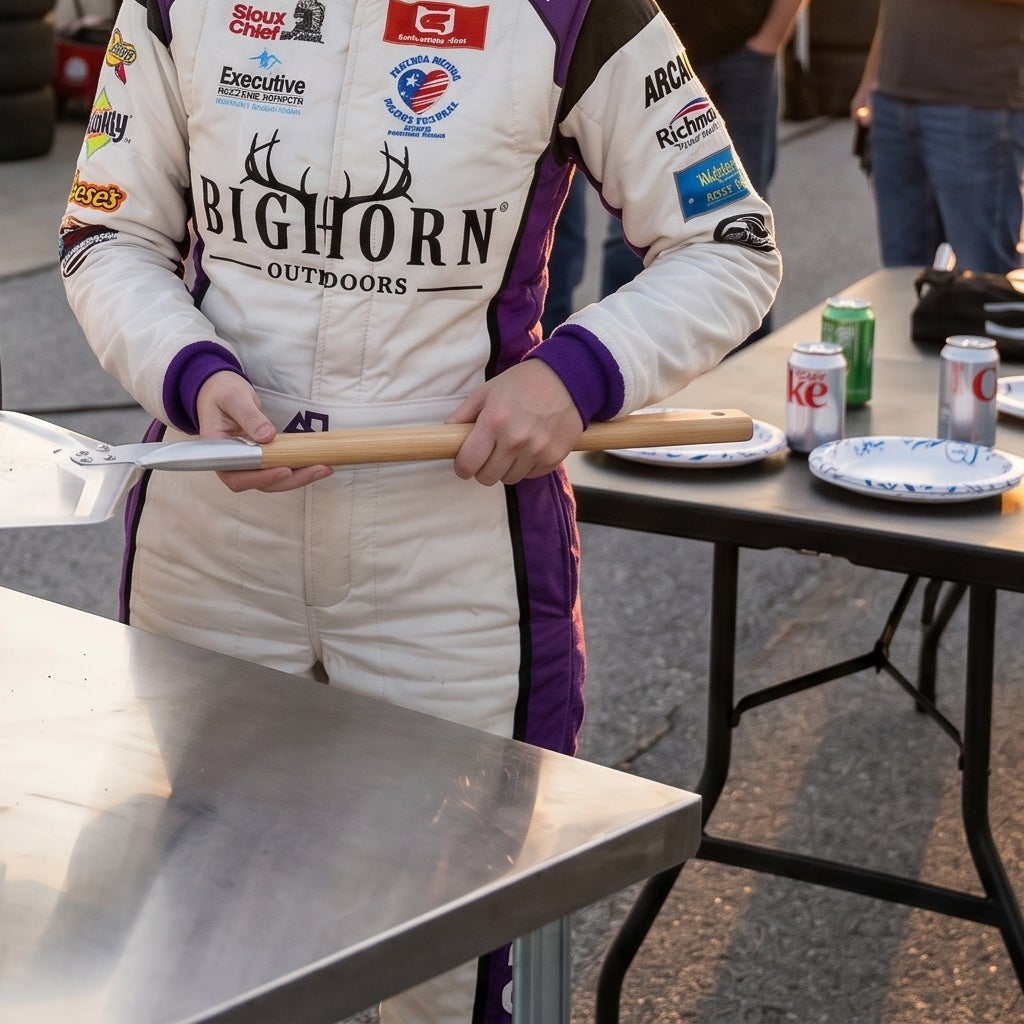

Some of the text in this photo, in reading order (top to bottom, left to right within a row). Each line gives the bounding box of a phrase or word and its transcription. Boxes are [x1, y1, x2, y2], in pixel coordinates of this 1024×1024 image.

[232, 3, 287, 26] Sioux
[229, 19, 281, 41] Chief
[219, 65, 306, 95] Executive
[200, 174, 498, 267] BIGHORN
[267, 262, 408, 296] OUTDOORS
